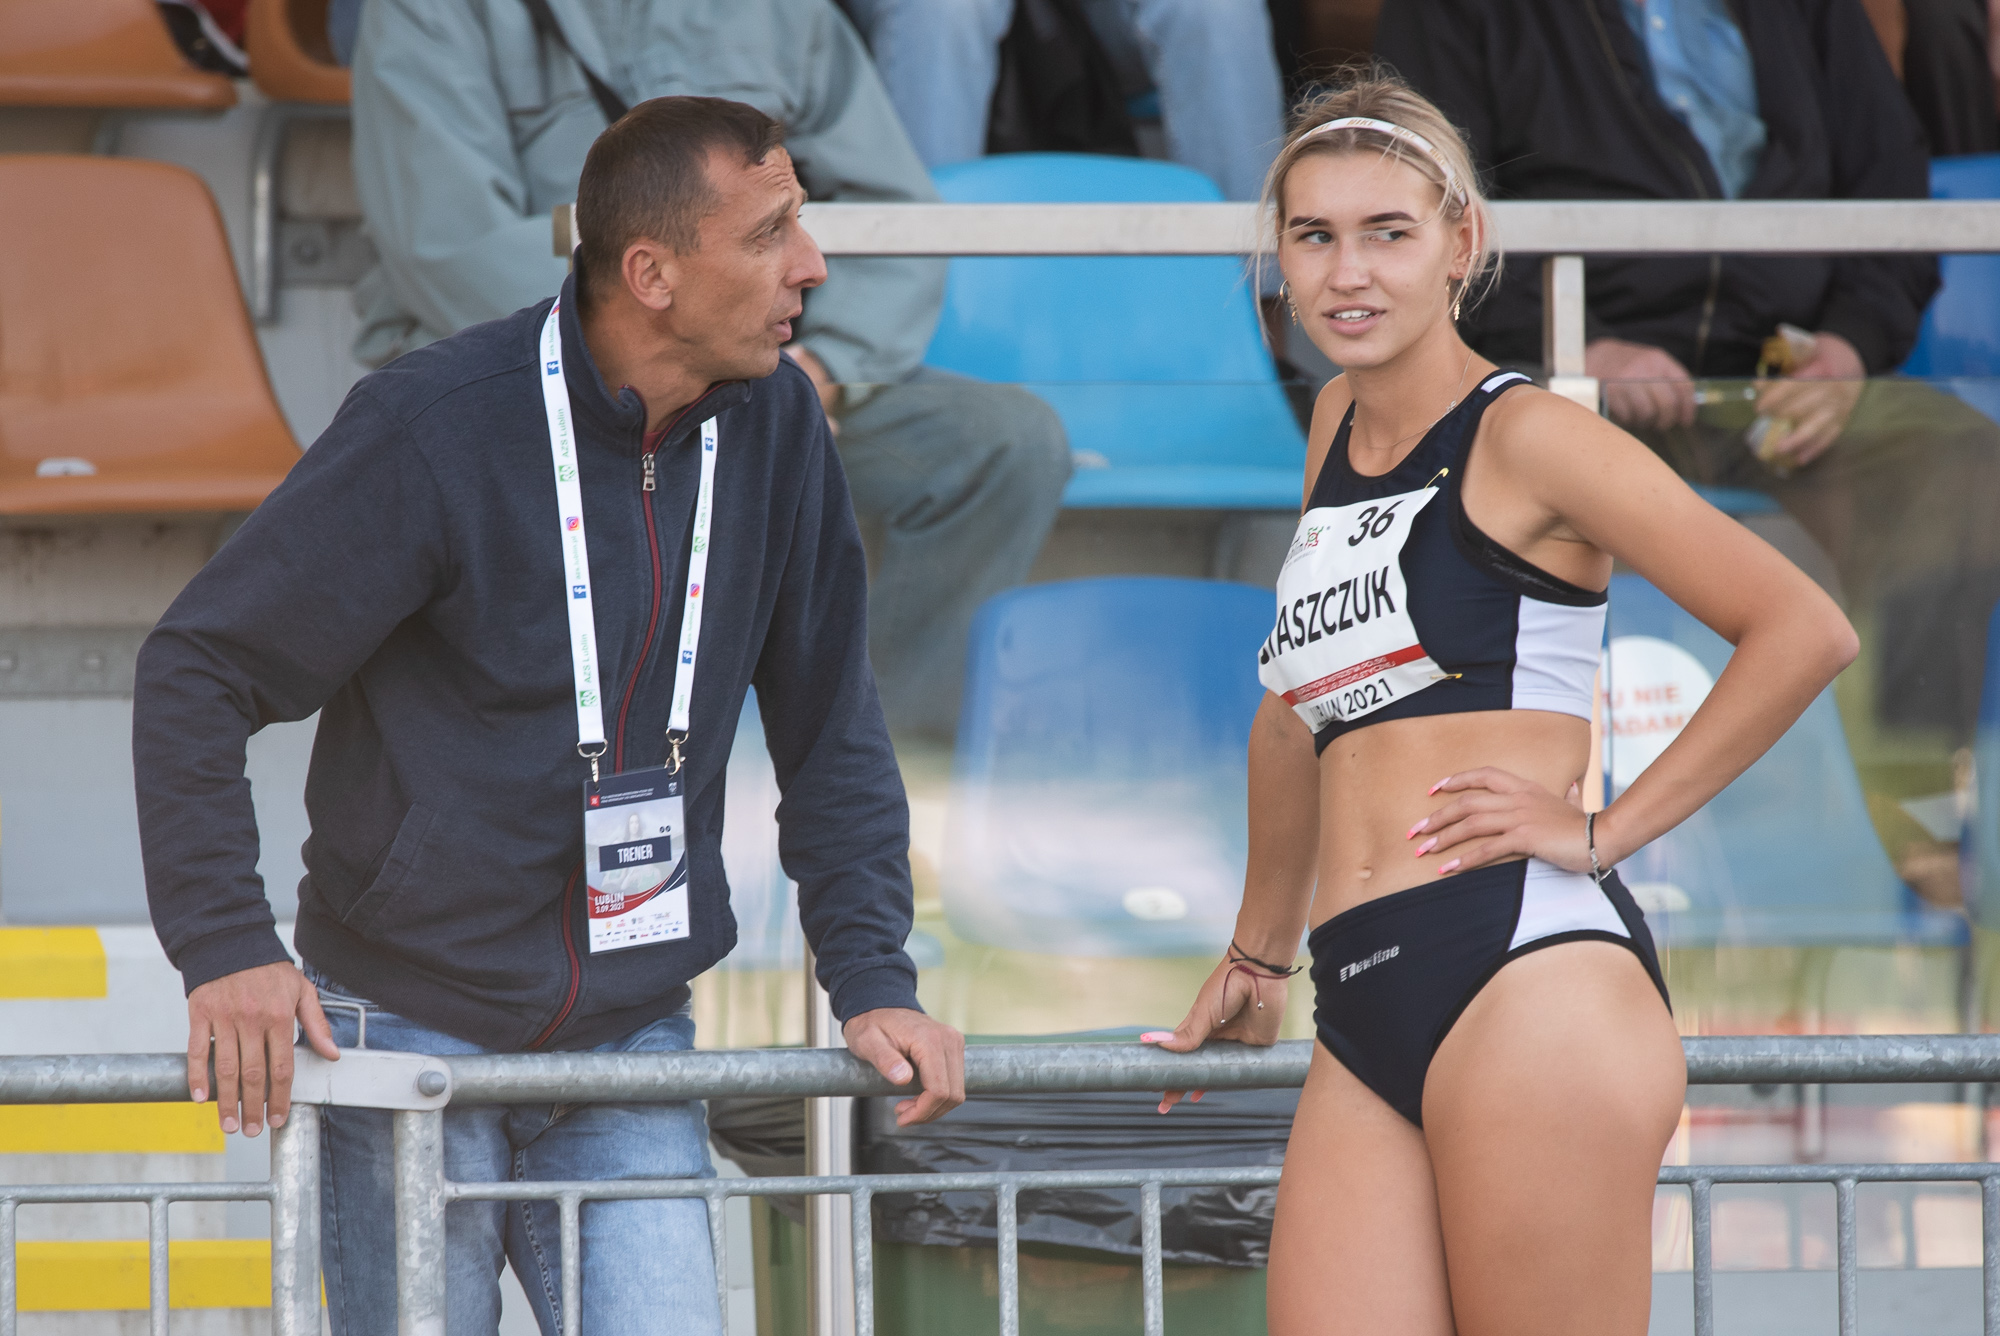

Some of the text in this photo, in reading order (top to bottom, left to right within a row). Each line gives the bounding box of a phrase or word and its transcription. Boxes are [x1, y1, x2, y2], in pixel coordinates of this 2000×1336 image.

[558, 408, 569, 458] AZS Lublin
[1348, 499, 1405, 547] 36
[581, 633, 592, 684] AZS Lublin
[1344, 677, 1394, 716] 2021
[617, 844, 654, 864] TRENER
[594, 892, 625, 906] LUBLIN
